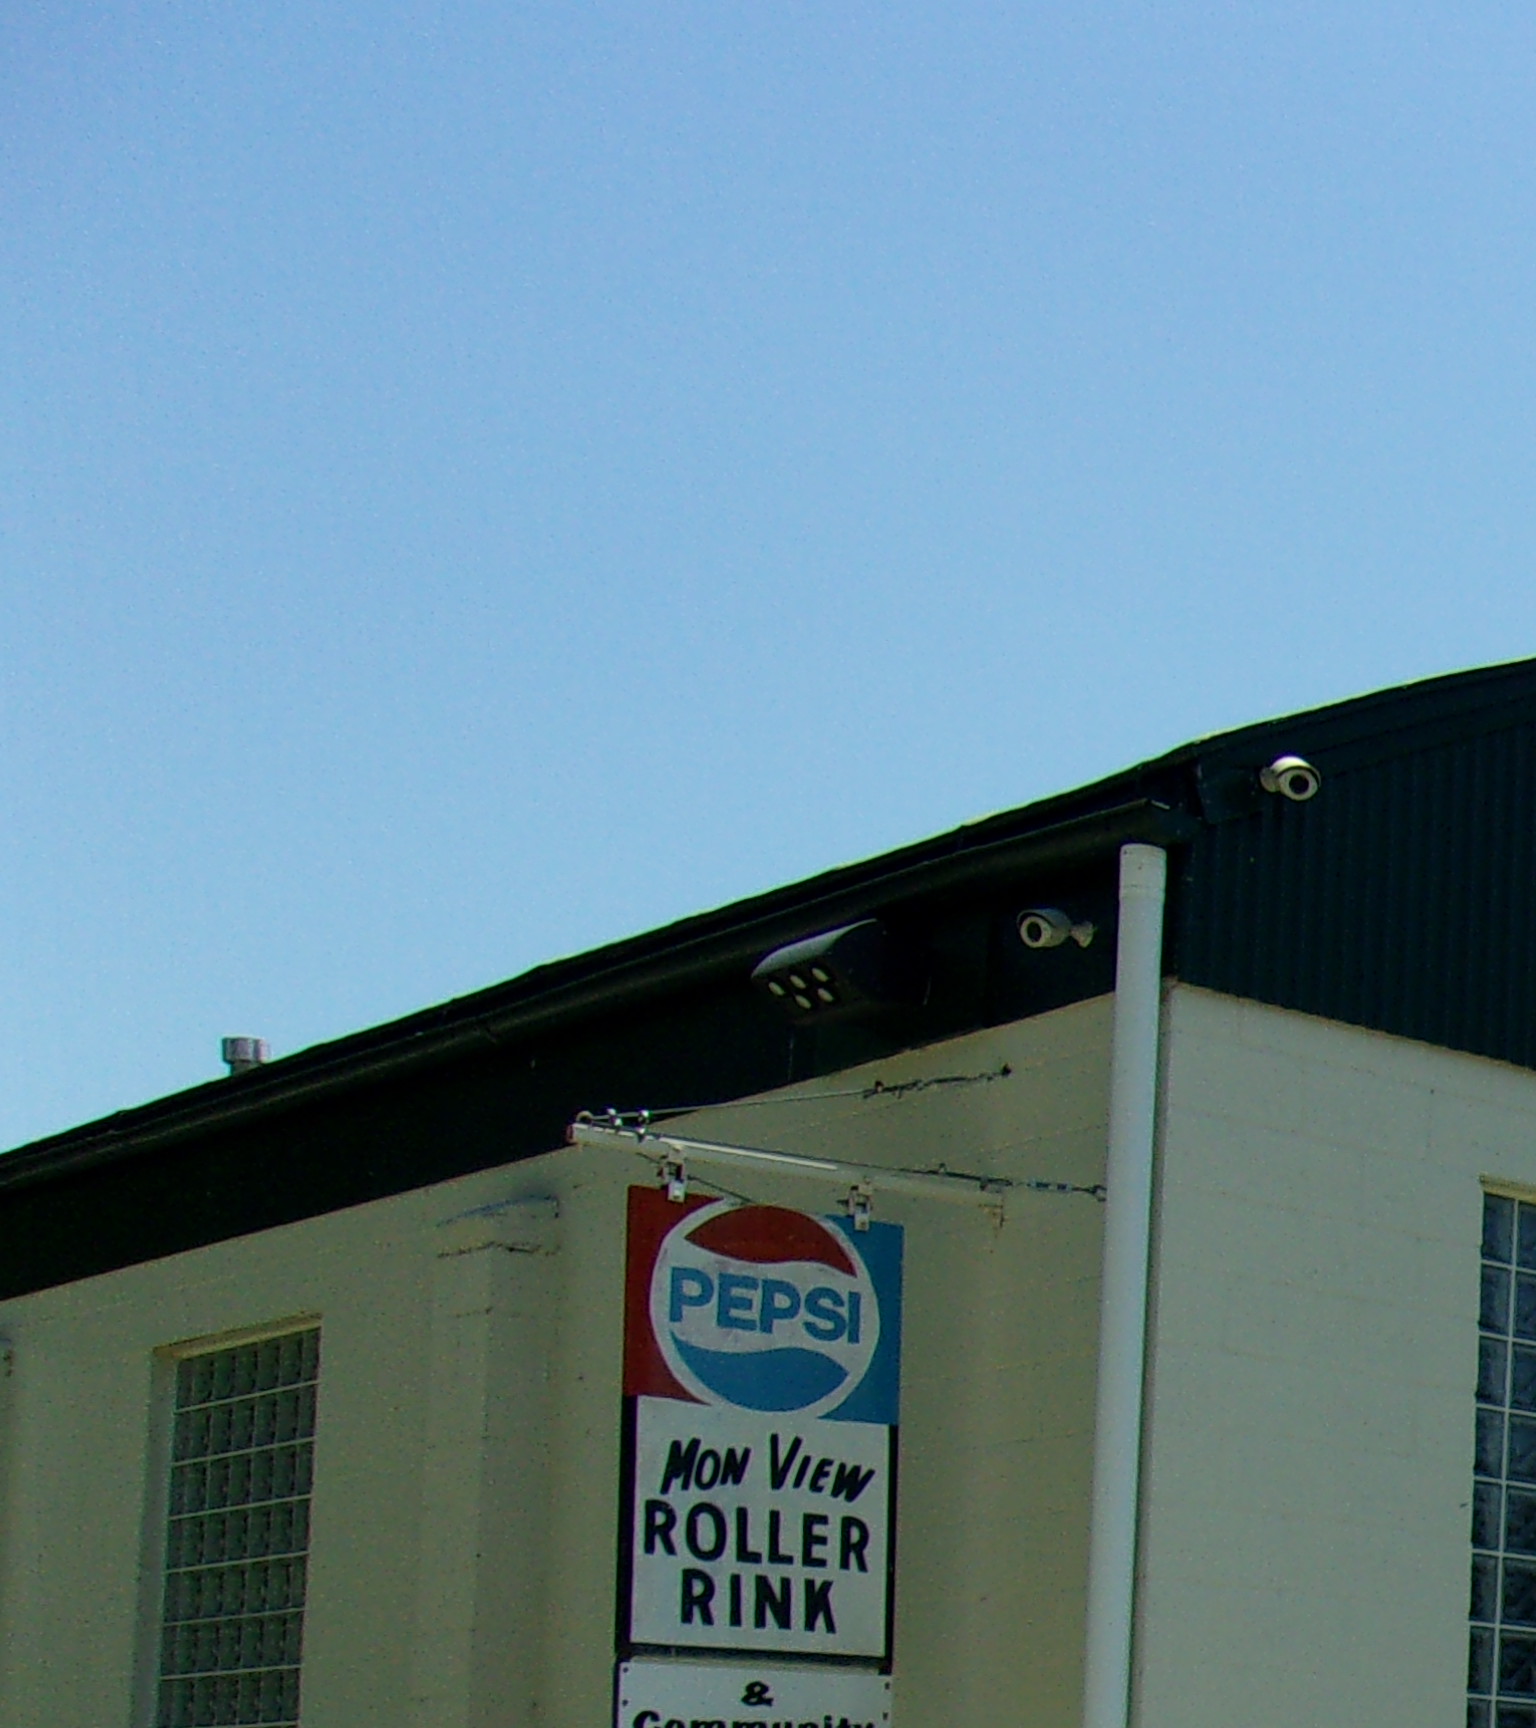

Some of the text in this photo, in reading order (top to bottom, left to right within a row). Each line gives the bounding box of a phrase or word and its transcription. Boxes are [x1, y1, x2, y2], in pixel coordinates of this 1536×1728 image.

[670, 1267, 860, 1344] PEPSI
[660, 1434, 875, 1502] MON VIEW
[643, 1500, 871, 1573] ROLLER
[680, 1569, 837, 1633] RINK
[741, 1682, 774, 1705] &
